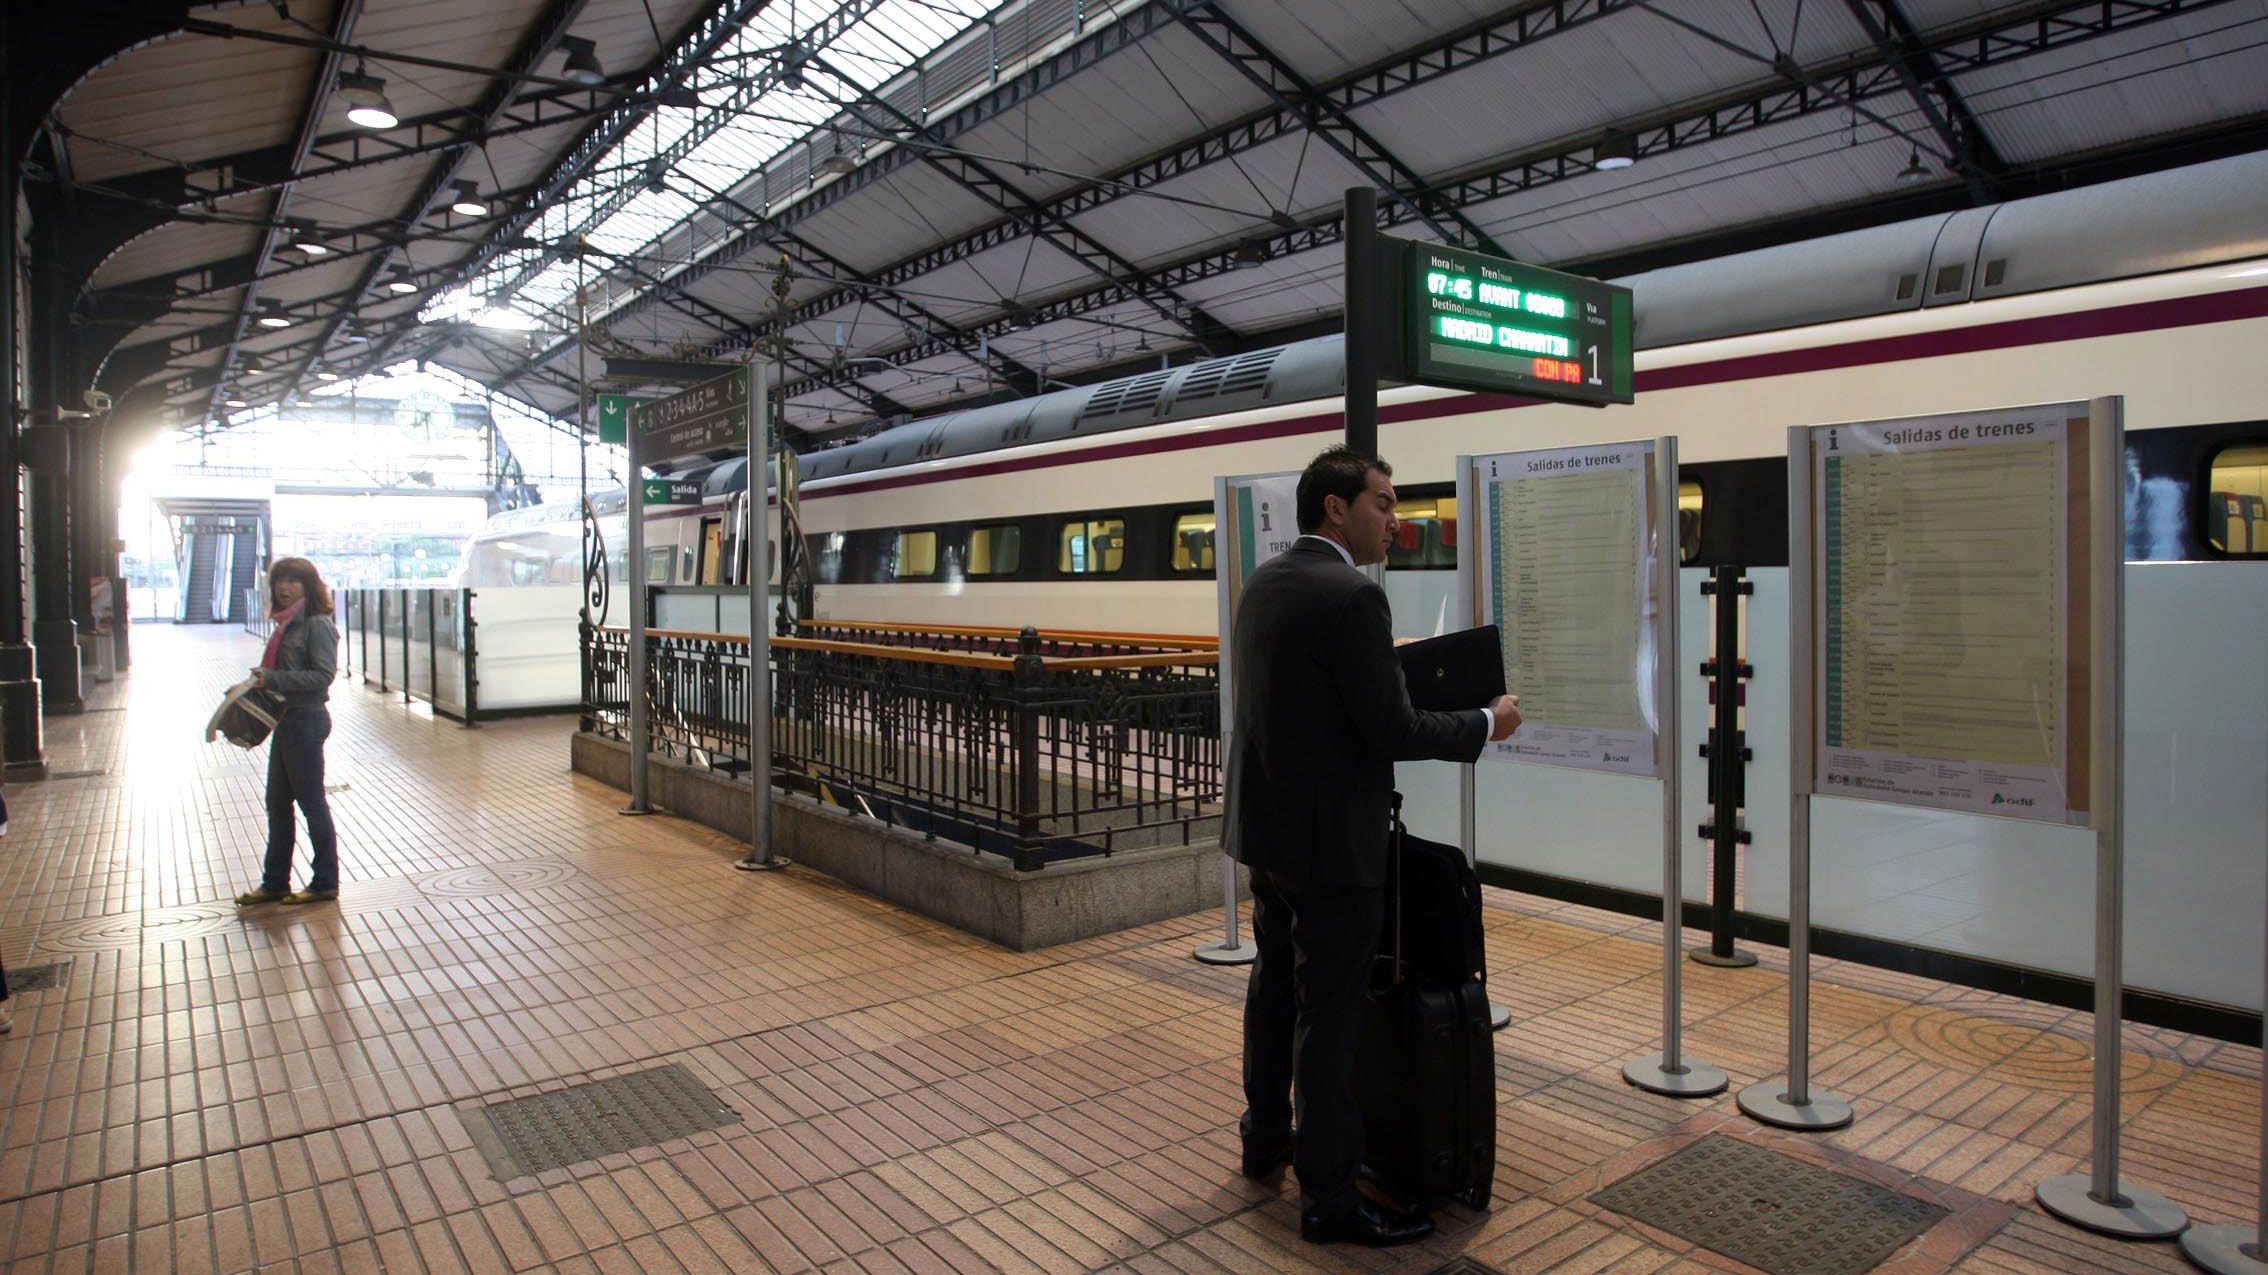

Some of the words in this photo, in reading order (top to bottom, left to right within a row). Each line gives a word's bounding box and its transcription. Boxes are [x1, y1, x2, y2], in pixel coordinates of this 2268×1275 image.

[1431, 256, 1450, 270] Hora
[1481, 266, 1498, 280] Tren
[1427, 272, 1472, 300] 07:45
[1478, 282, 1521, 310] AVANT
[1432, 297, 1462, 313] Destino
[1441, 316, 1493, 345] MADRID
[1563, 361, 1582, 385] PA
[1587, 344, 1603, 385] 1
[1883, 427, 1942, 445] Salidas
[1948, 425, 1969, 440] de
[1976, 422, 2035, 438] trenes
[1527, 458, 1564, 473] Salidas
[1567, 457, 1581, 468] de
[1585, 454, 1621, 467] trenes
[671, 484, 698, 495] Salida
